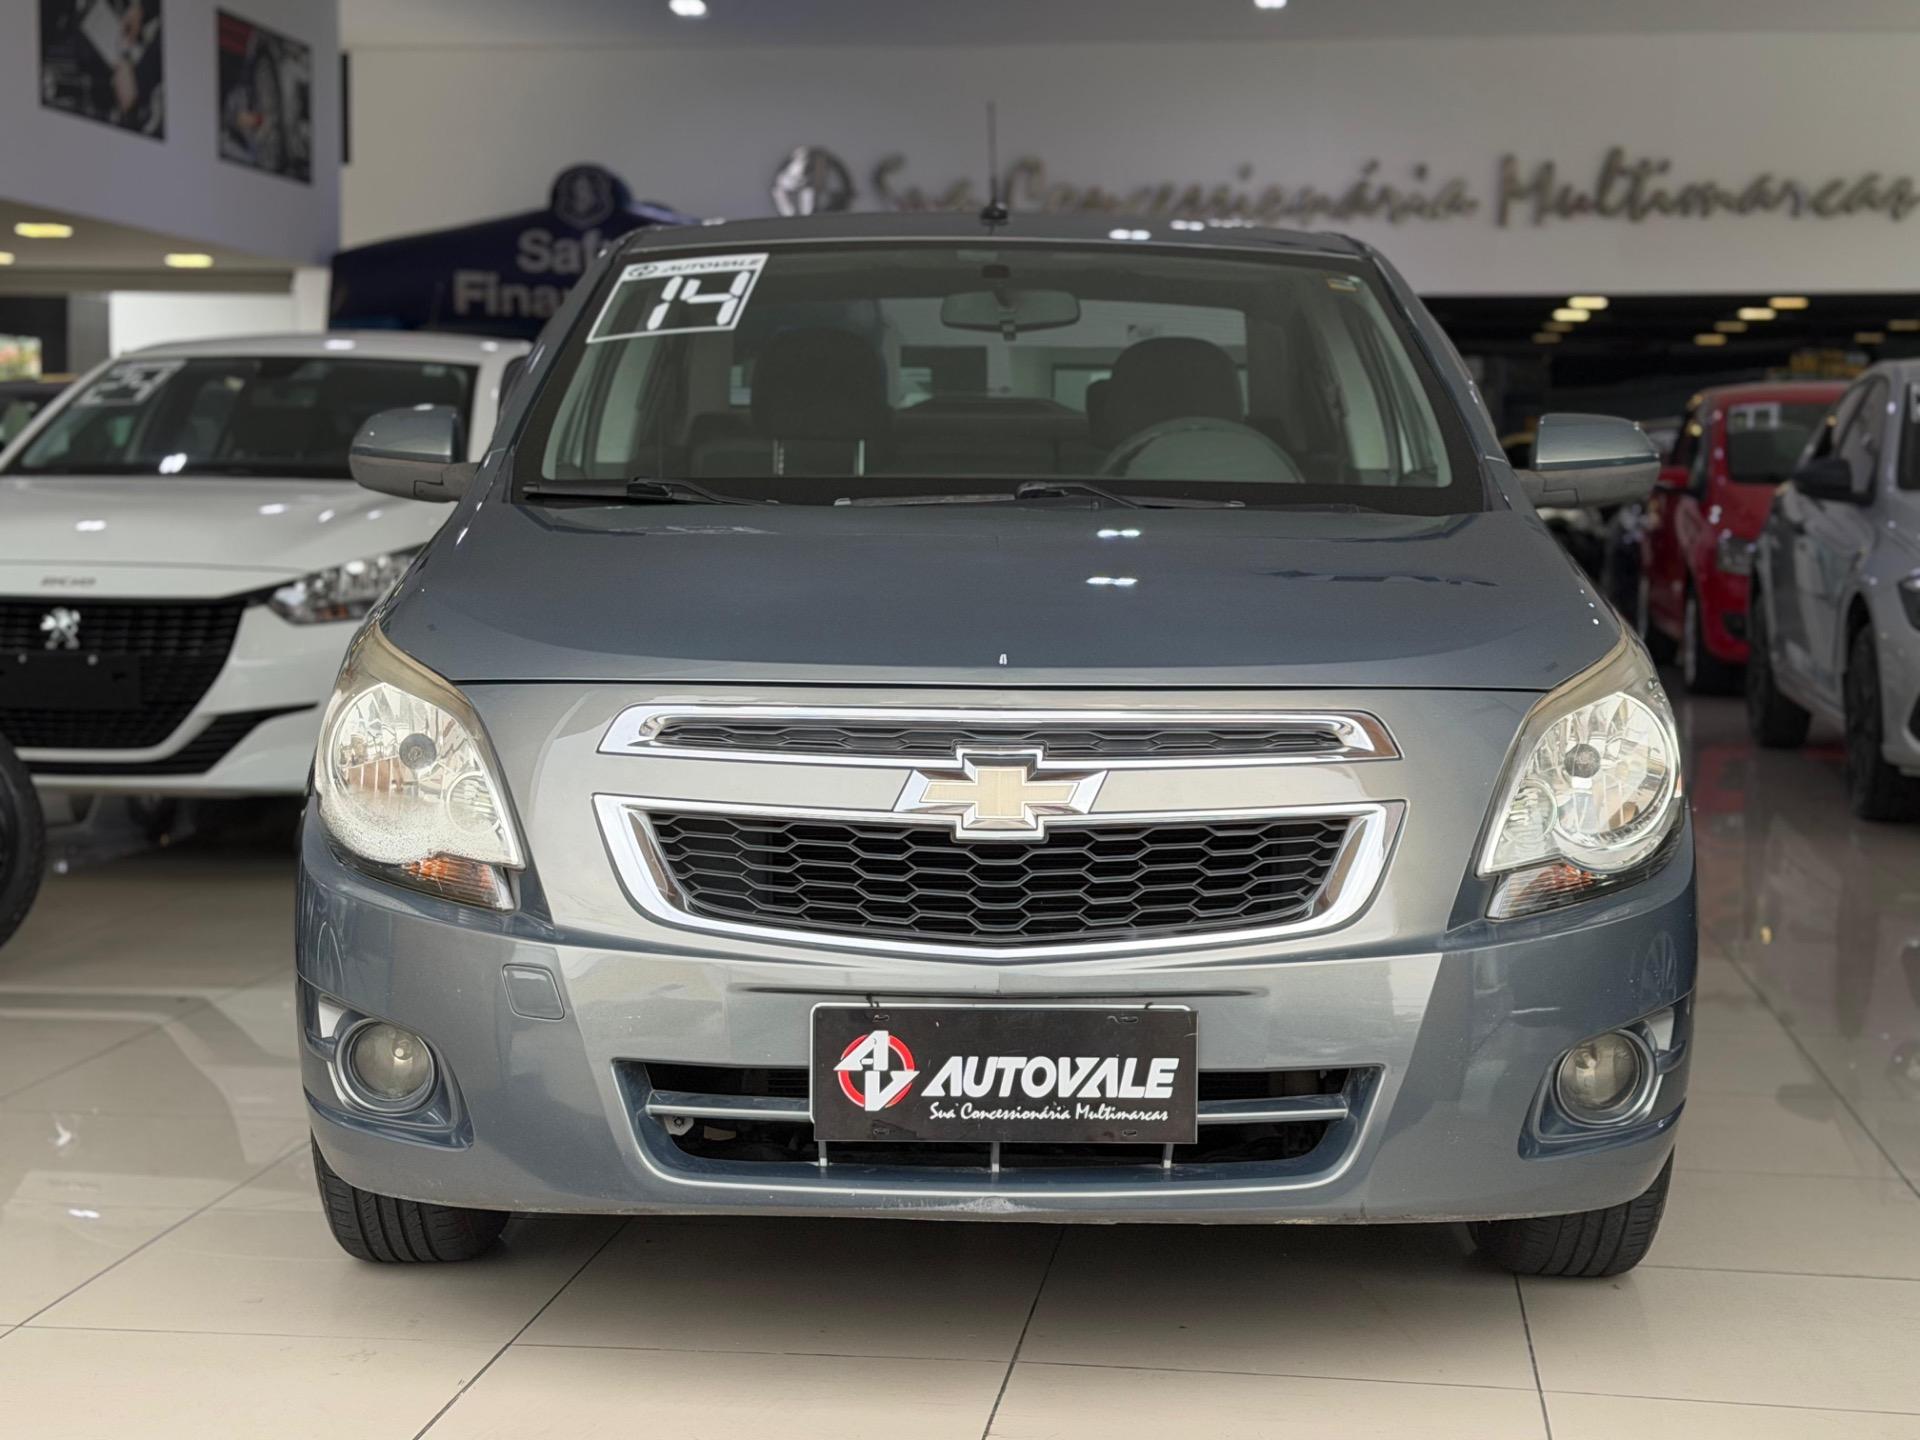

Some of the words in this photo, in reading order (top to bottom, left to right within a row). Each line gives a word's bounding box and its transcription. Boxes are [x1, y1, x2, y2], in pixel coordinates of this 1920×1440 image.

[1497, 145, 1920, 228] Multimarcas
[517, 228, 612, 275] Saf
[454, 268, 577, 318] Fina
[646, 270, 750, 331] 14
[920, 1055, 1180, 1099] AUTOVALE
[929, 1101, 956, 1120] Sua
[960, 1101, 1071, 1120] Concessionária
[1075, 1102, 1169, 1122] Multimarcas
